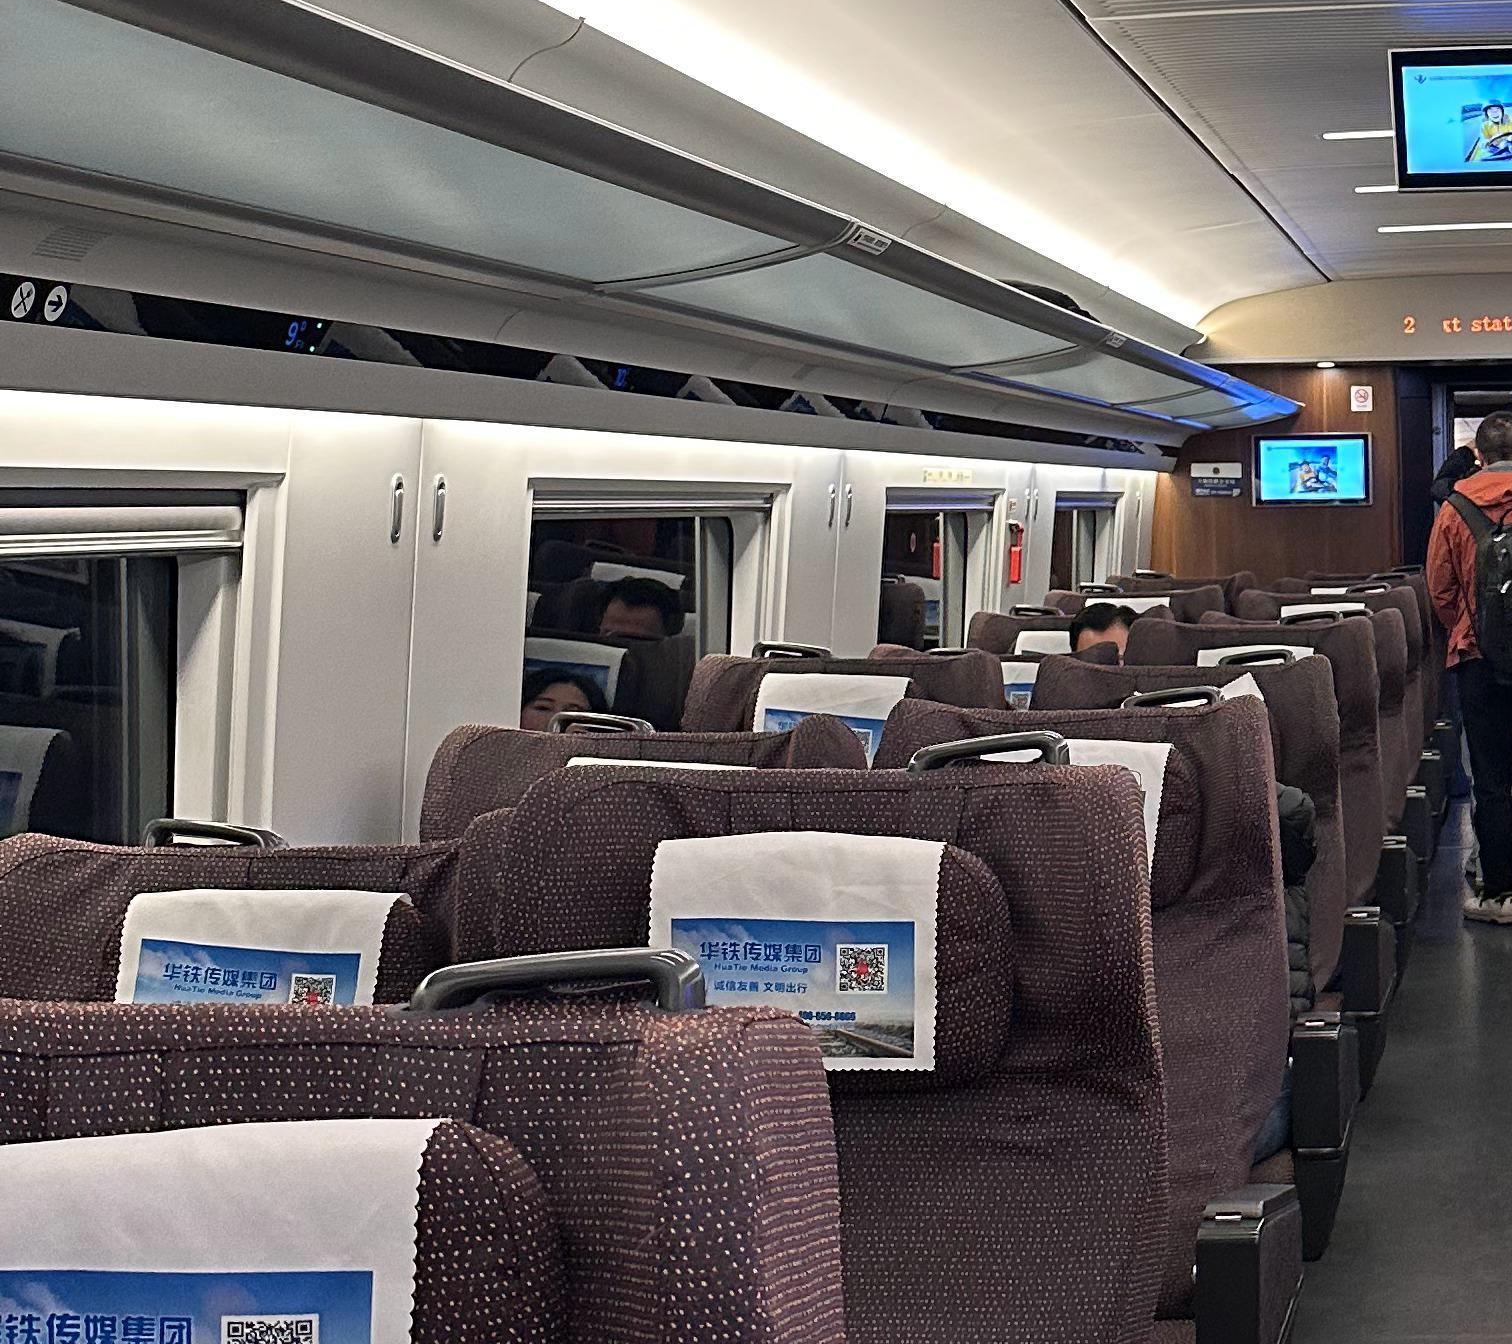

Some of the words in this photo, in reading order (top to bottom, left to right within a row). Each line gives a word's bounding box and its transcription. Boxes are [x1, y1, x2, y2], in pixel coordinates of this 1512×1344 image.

[1403, 316, 1416, 334] 2
[699, 941, 822, 963] 华铁传媒集团
[163, 962, 278, 990] 华铁传媒集团
[762, 981, 808, 994] 文明出行
